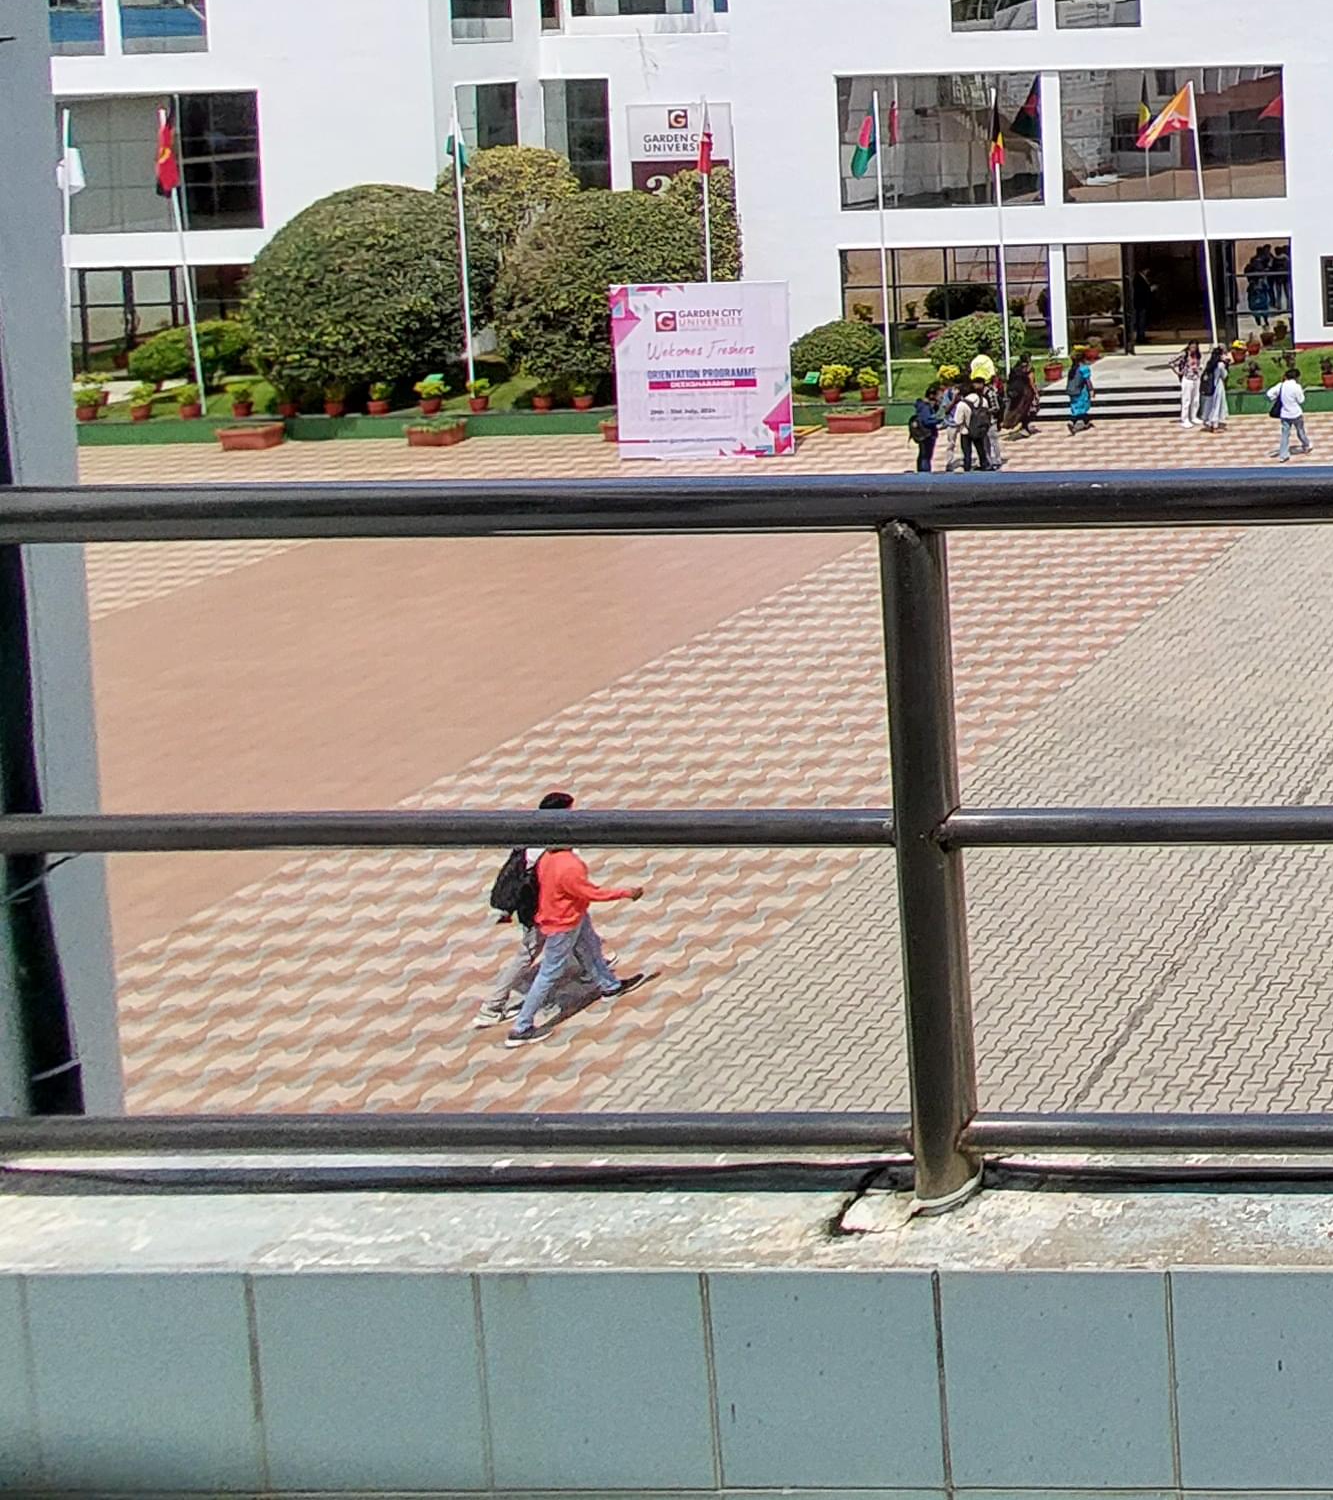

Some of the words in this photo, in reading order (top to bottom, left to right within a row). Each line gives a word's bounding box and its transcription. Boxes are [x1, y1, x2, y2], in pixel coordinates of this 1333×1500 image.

[643, 133, 688, 144] GARDEN
[643, 142, 700, 152] UNIVERSI
[678, 309, 719, 318] GARDEN
[721, 308, 743, 317] CITY
[678, 317, 743, 327] UNIVERSITY
[705, 339, 756, 358] Freshers
[647, 369, 700, 380] ORIENTATION
[702, 367, 756, 378] PROGRAMME
